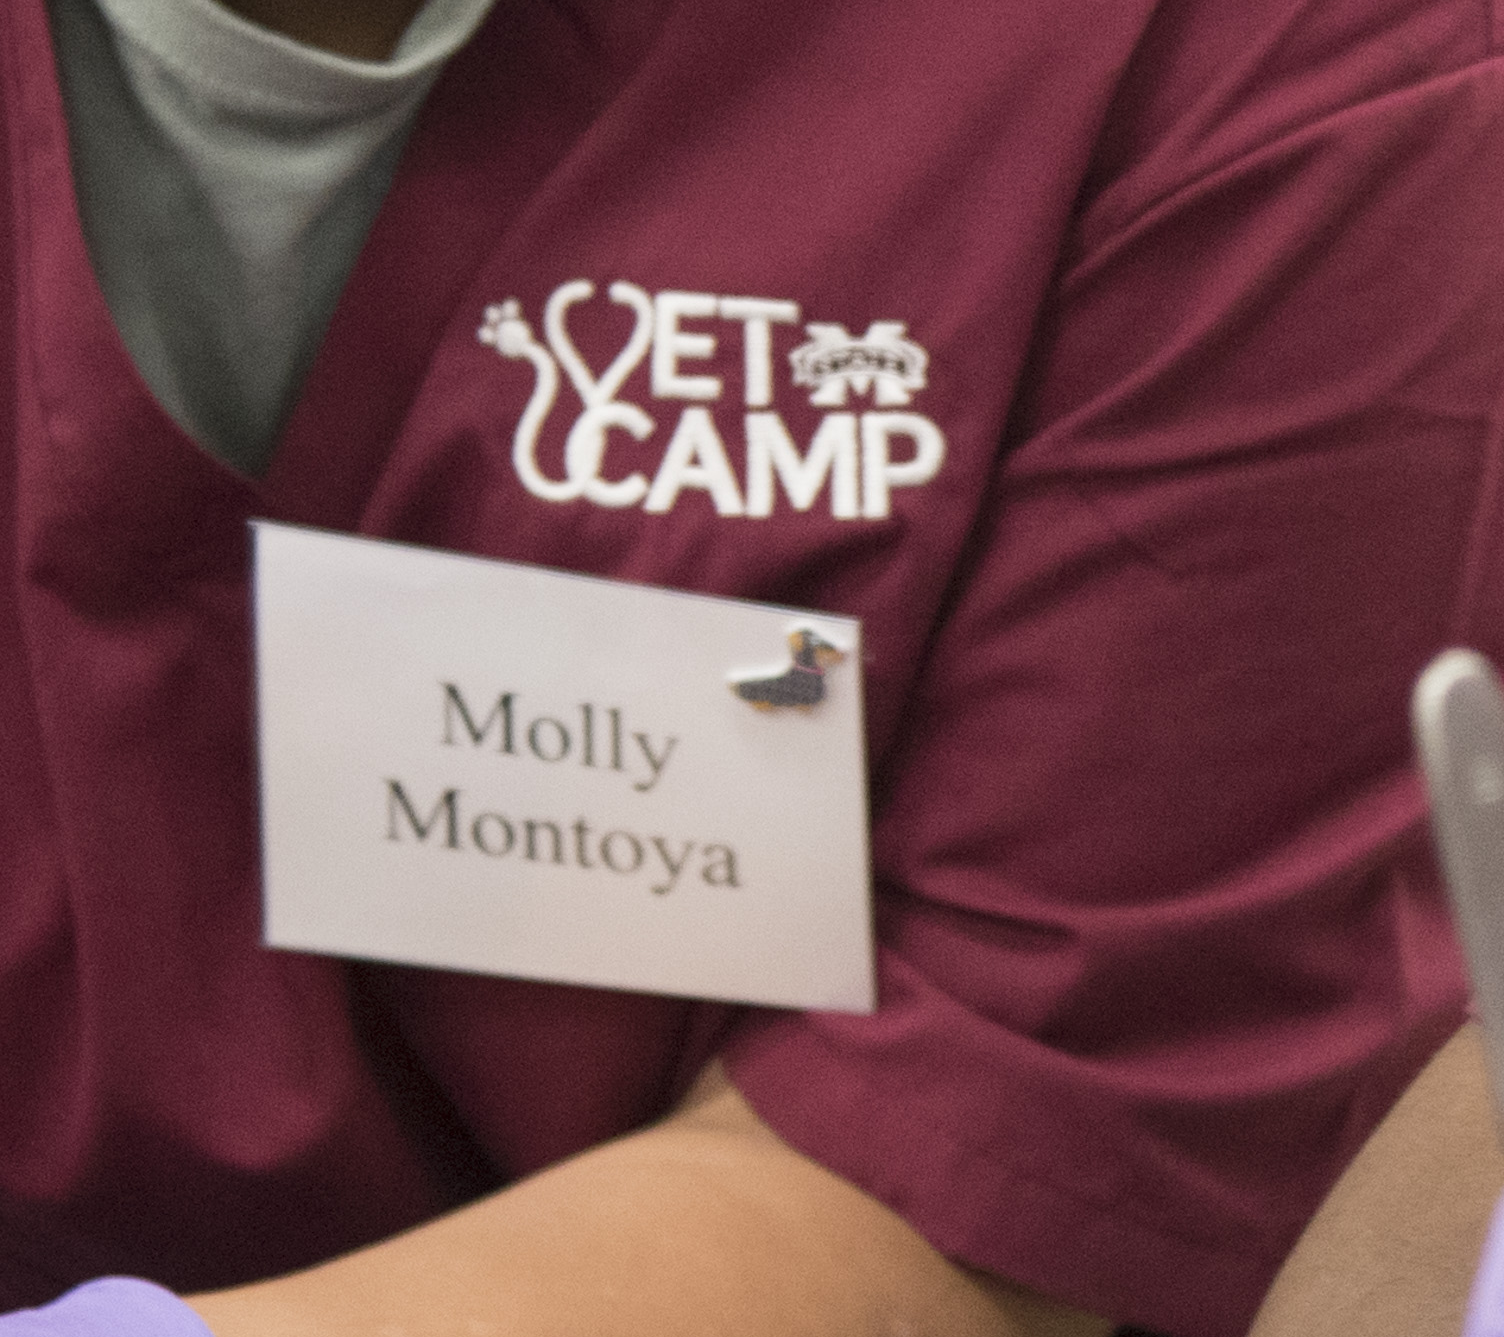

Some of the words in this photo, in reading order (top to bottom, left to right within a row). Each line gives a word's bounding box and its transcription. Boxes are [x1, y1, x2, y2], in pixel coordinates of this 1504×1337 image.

[545, 280, 800, 408] VET
[566, 403, 946, 519] CAMP
[440, 681, 679, 792] Molly
[383, 778, 743, 896] Montoya
